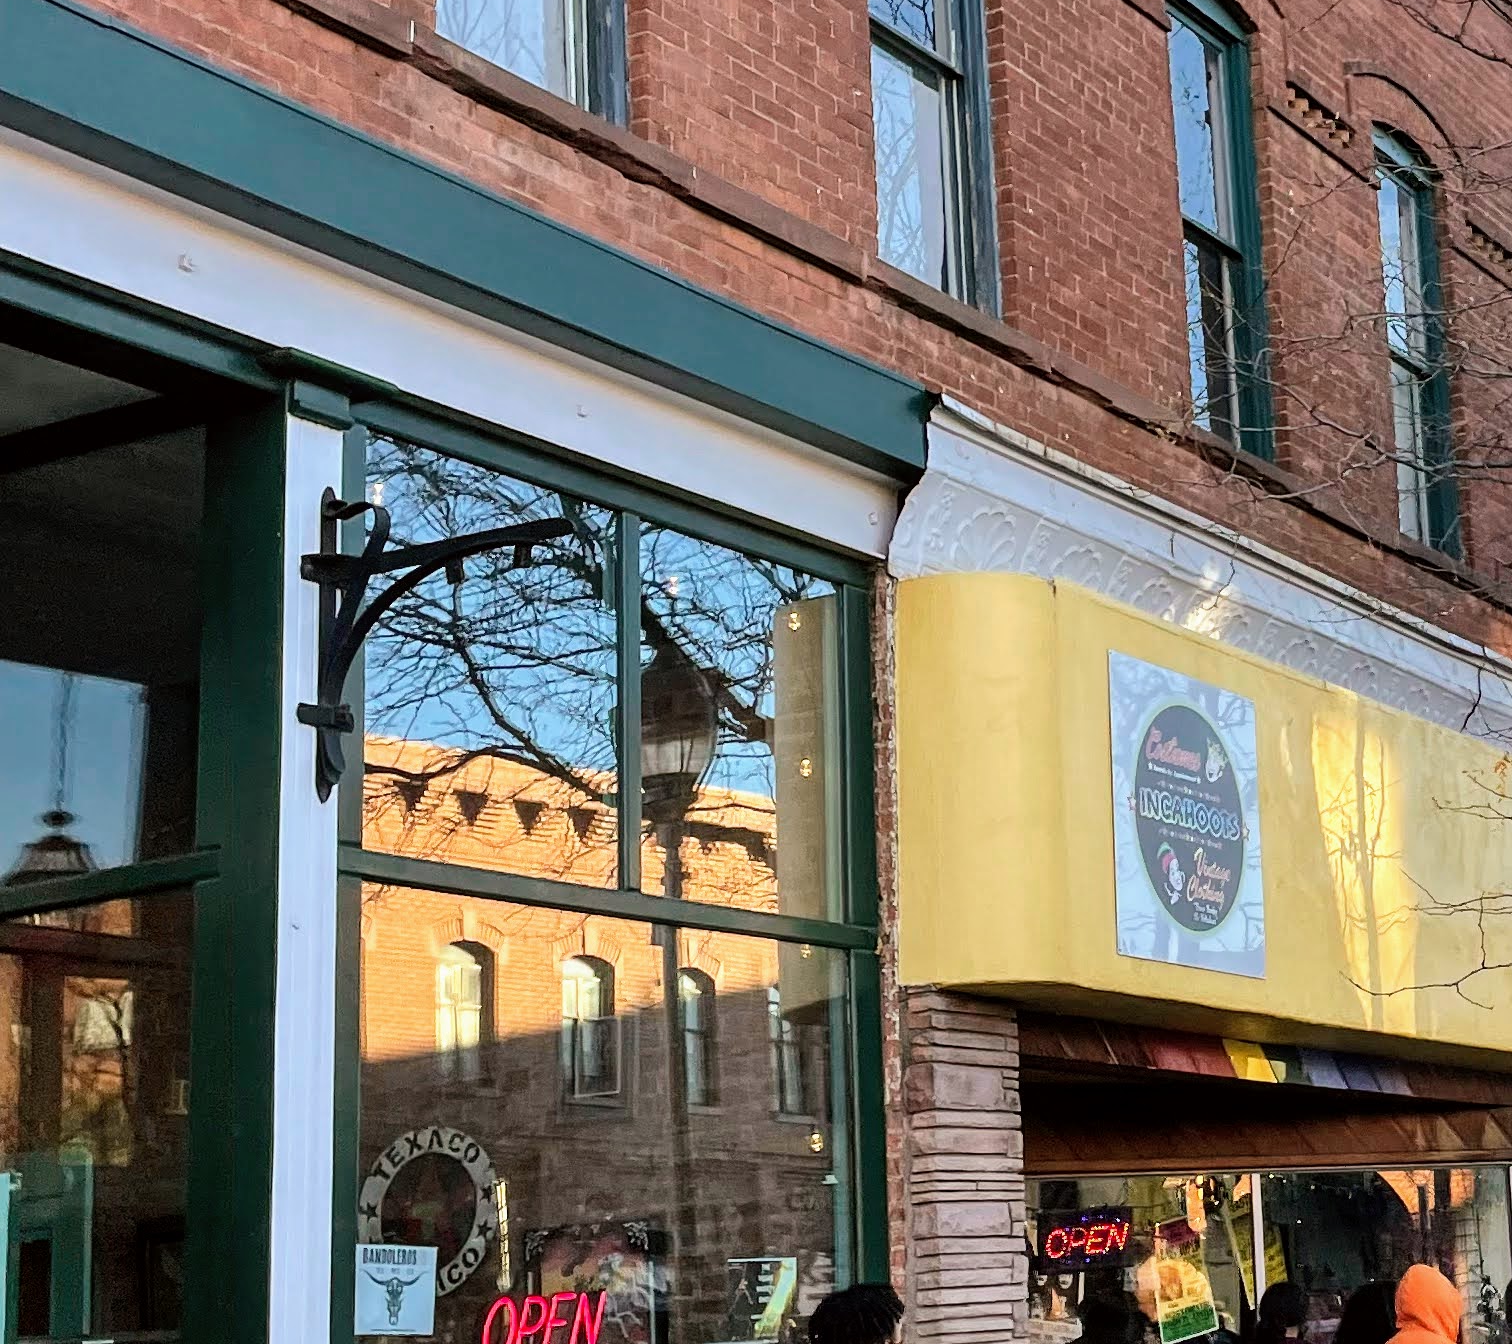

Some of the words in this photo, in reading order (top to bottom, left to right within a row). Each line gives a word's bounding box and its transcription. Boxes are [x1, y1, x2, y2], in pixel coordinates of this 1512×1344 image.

[1140, 787, 1240, 840] INCAHOOTS
[371, 1129, 481, 1181] TEXACO
[362, 1247, 417, 1265] BANDOLEROS
[1045, 1222, 1129, 1258] OPEN
